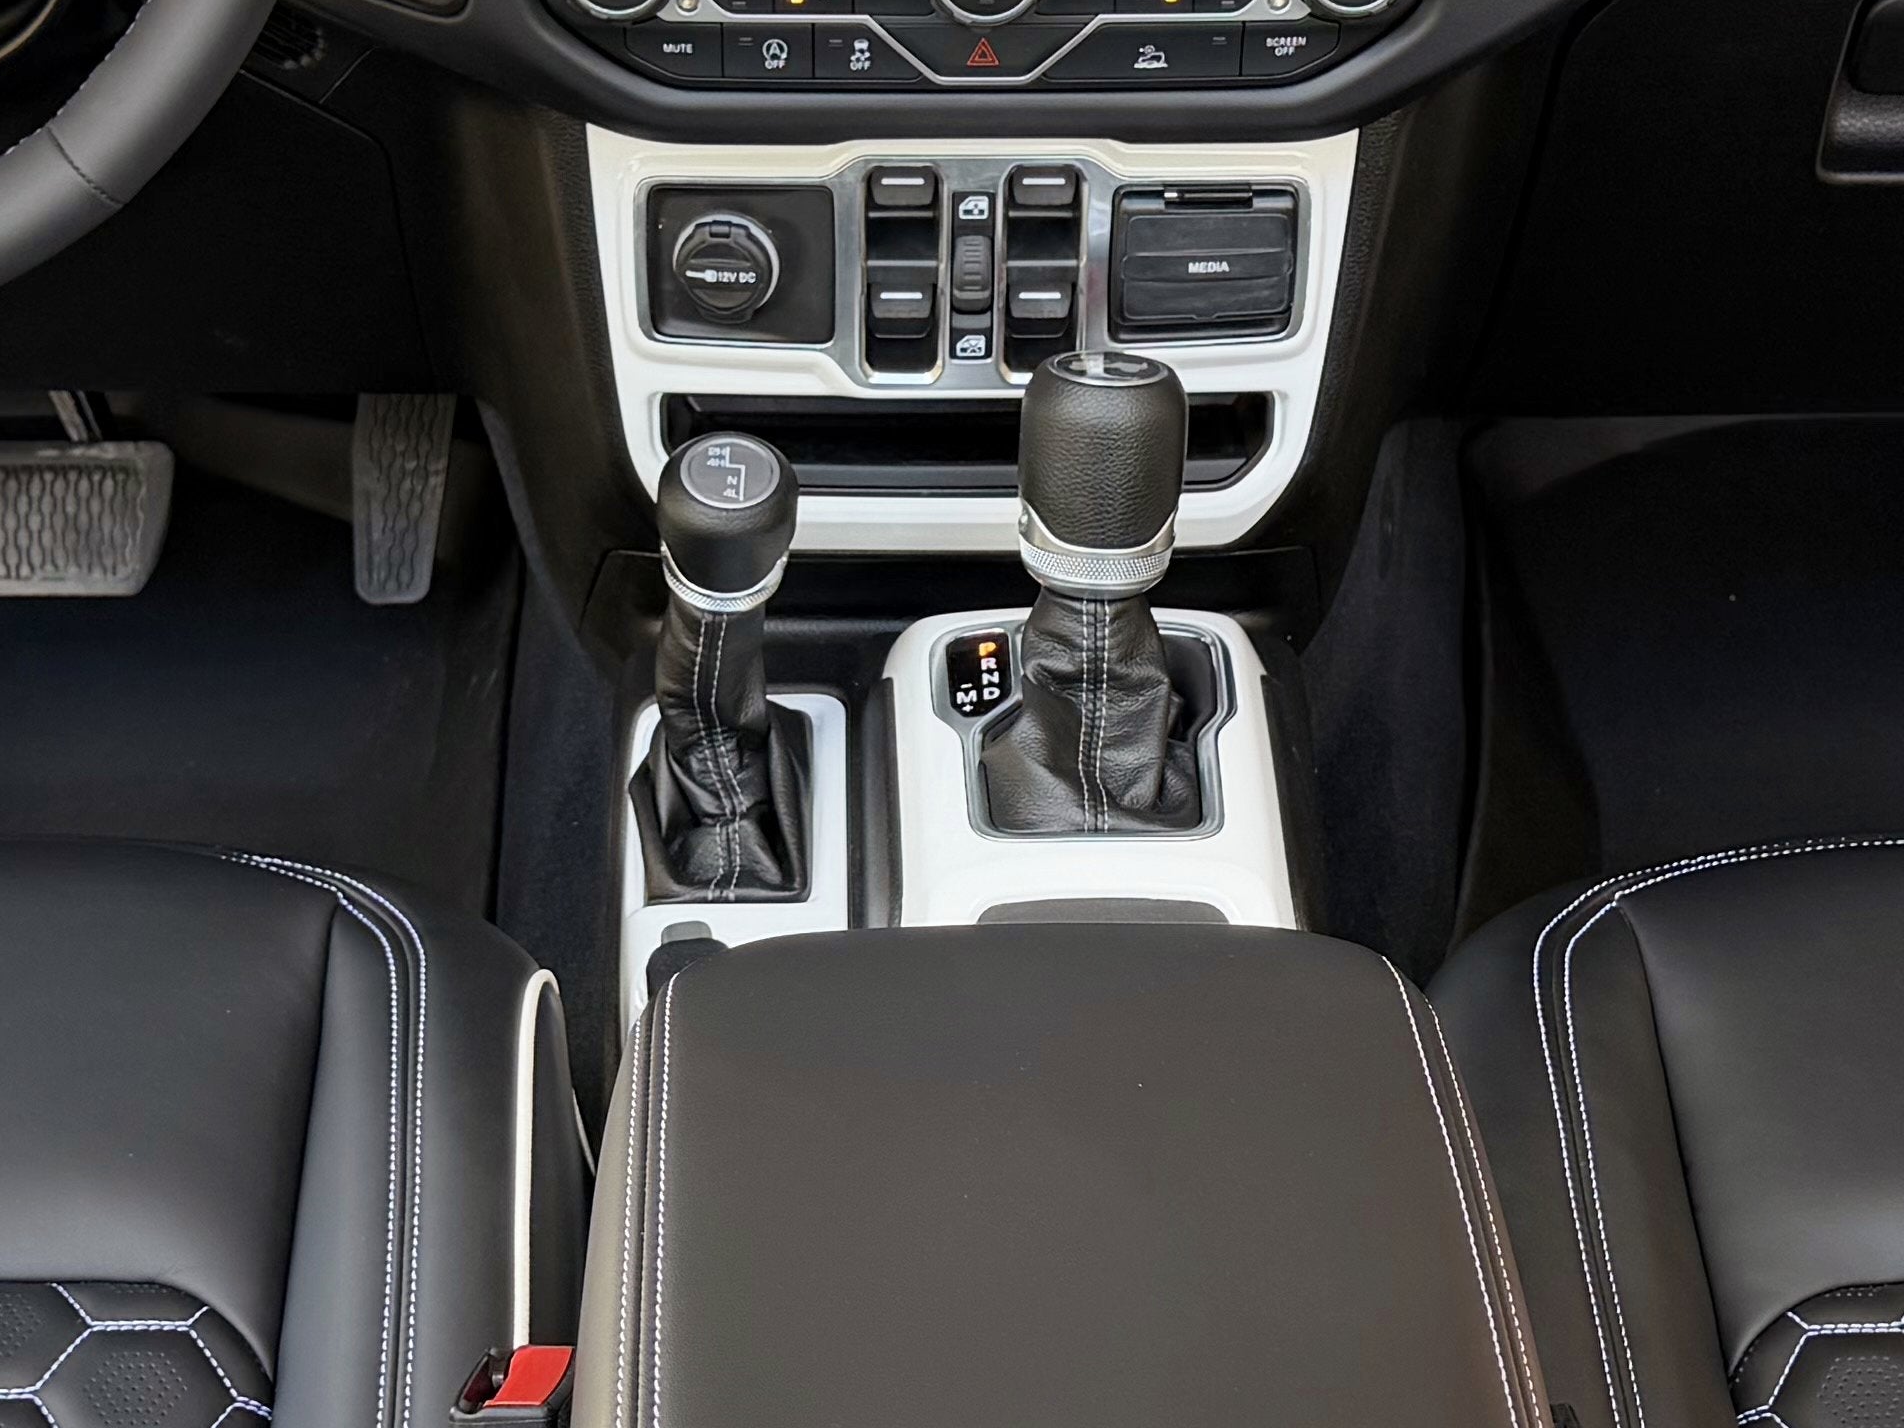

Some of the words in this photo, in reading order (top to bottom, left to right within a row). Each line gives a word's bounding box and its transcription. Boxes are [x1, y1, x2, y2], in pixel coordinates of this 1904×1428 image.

[662, 42, 694, 54] MUTE
[1266, 36, 1306, 49] SCREEN
[1275, 46, 1295, 57] OFF
[764, 59, 786, 71] OFF
[849, 61, 871, 72] OFF
[1188, 261, 1230, 274] MEDIA
[718, 271, 737, 283] 12V
[738, 272, 757, 284] DC
[727, 475, 738, 485] N
[979, 641, 996, 657] P
[980, 657, 997, 671] R
[982, 671, 1000, 685] N
[956, 689, 977, 704] M
[983, 686, 1001, 700] D
